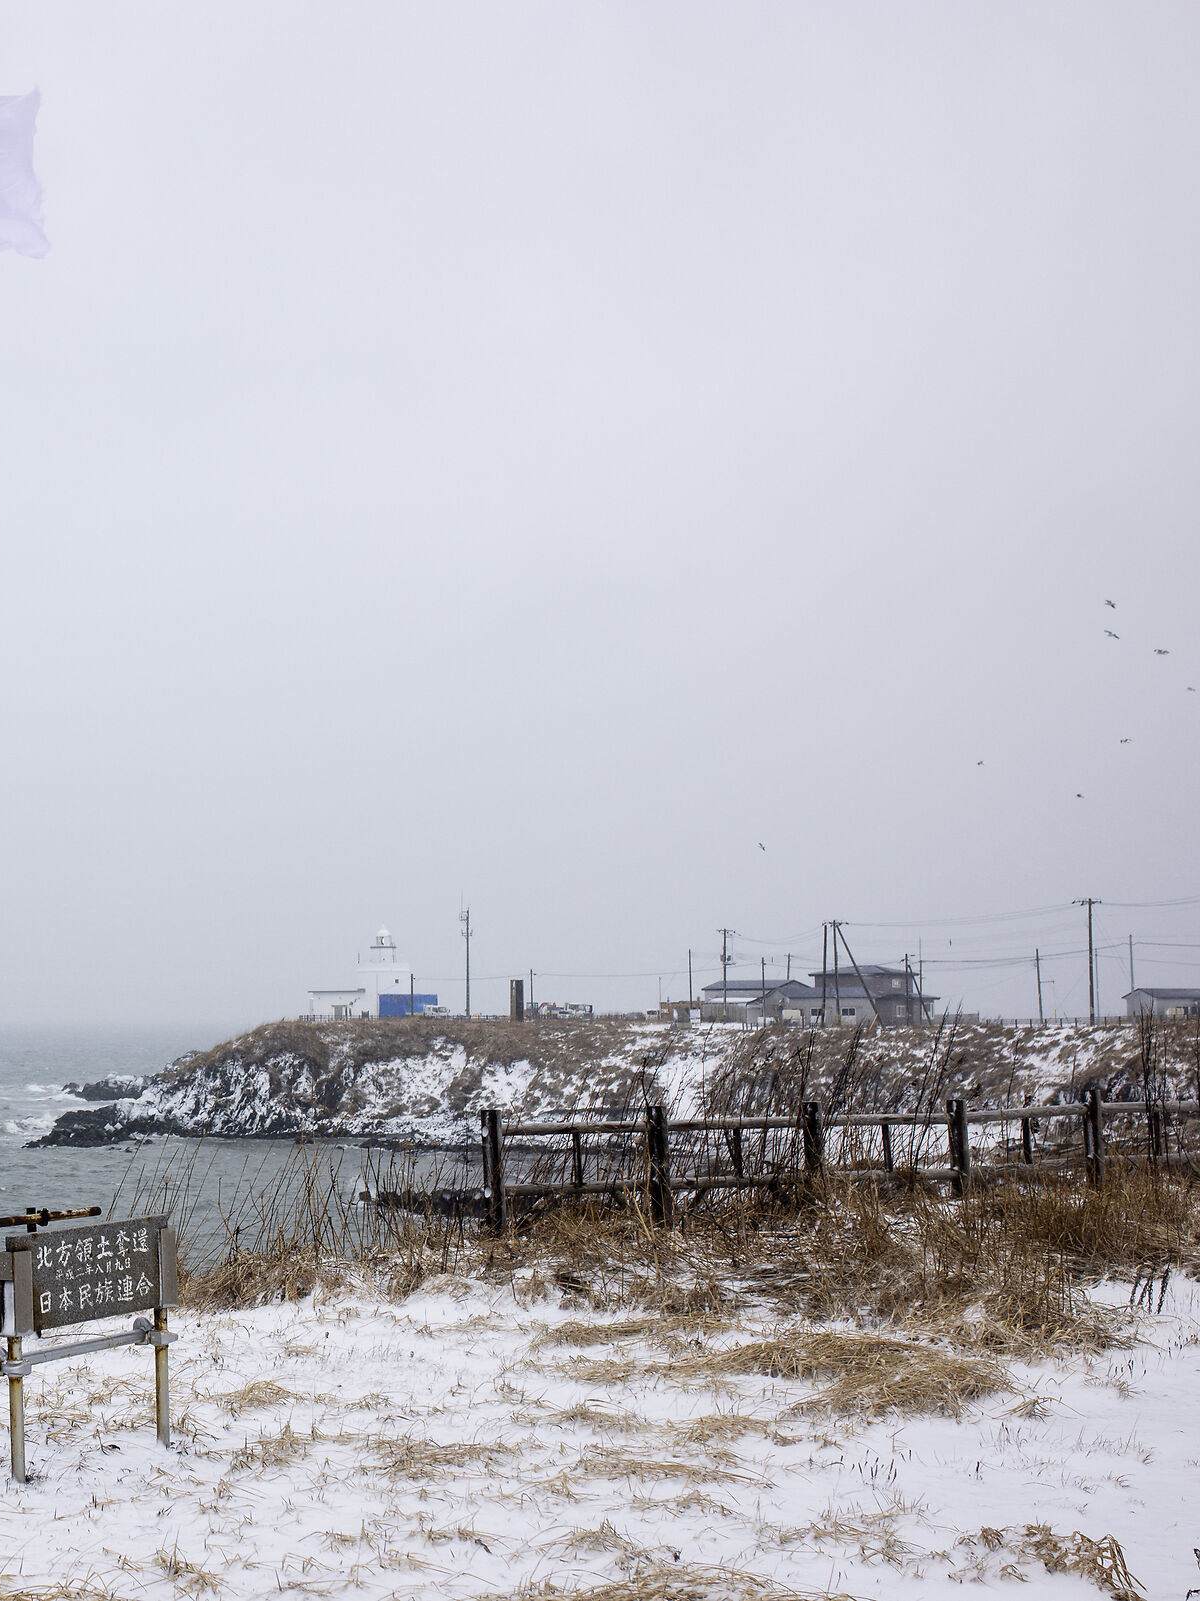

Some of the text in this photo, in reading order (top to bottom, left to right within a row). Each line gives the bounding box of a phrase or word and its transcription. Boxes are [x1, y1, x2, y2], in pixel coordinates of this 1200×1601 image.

[39, 1272, 154, 1314] 日本民族連合
